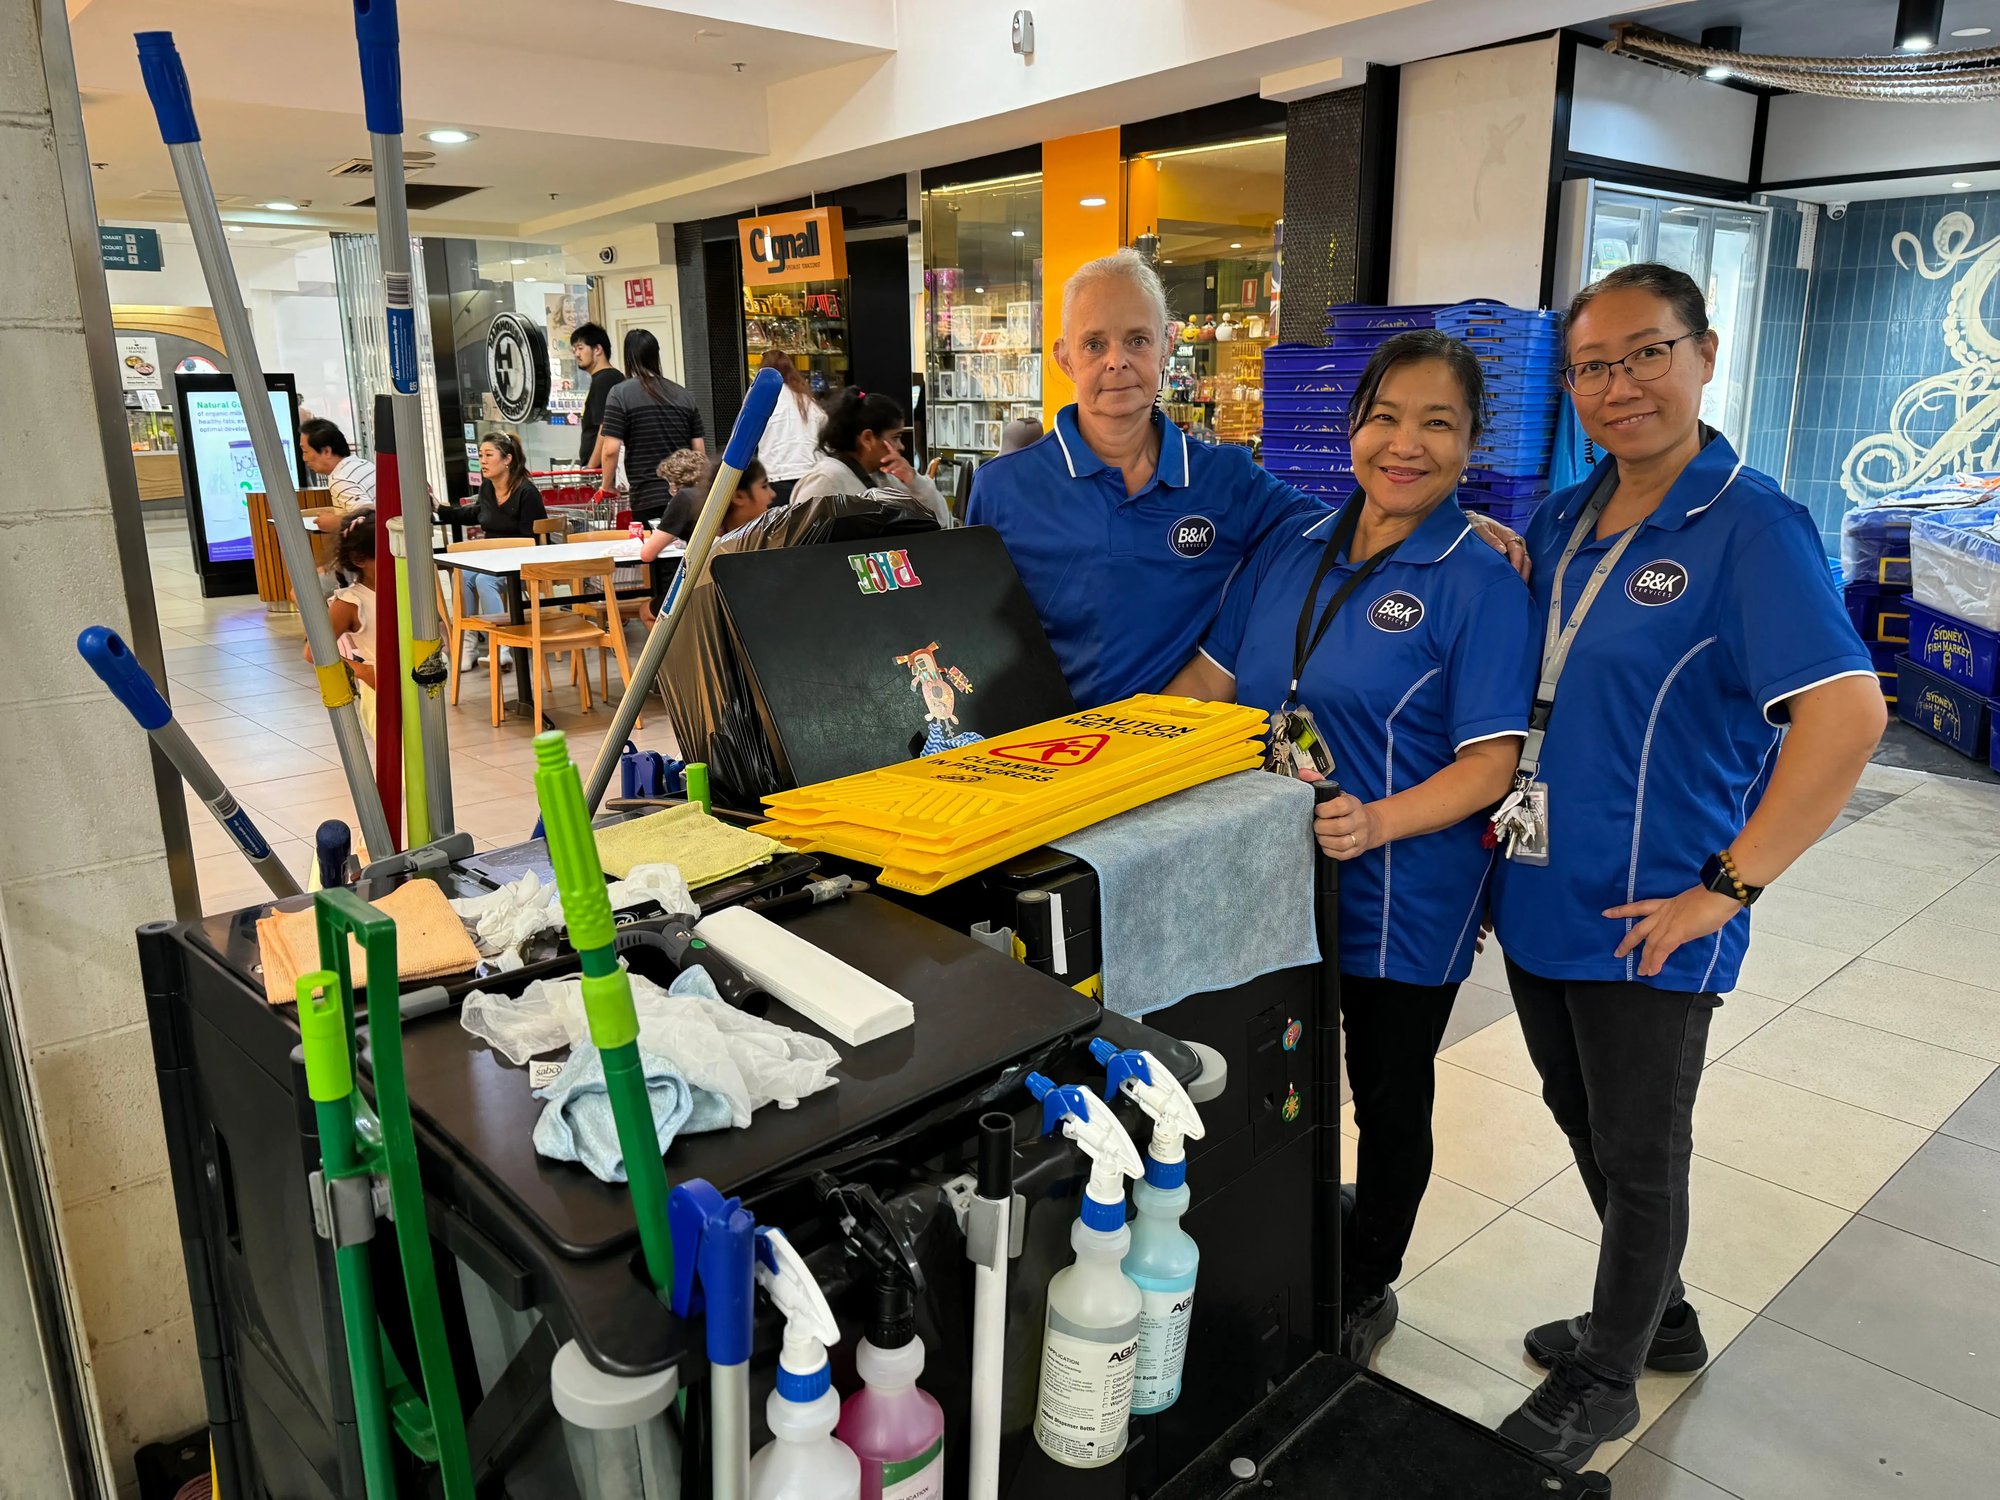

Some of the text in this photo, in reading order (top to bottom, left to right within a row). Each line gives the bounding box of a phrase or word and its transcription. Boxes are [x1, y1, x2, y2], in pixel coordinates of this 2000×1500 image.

[750, 220, 820, 274] Cignall
[197, 401, 229, 409] Natural
[1178, 527, 1210, 543] B&K
[1636, 570, 1682, 592] B&K
[1634, 586, 1672, 598] SERVICES
[1374, 612, 1408, 627] SERVICES
[1378, 600, 1420, 622] B&K
[1934, 628, 1962, 644] SYDNEY
[1928, 641, 1971, 660] FISH MARKET
[1926, 692, 1953, 710] SYDNEY
[1064, 718, 1181, 738] WET FLOOR
[1080, 713, 1198, 734] CAUTION
[927, 758, 1054, 782] IN PROGRESS
[962, 756, 1060, 774] CLEANING
[1048, 1345, 1080, 1366] APPLICATION
[1054, 1417, 1078, 1429] Dispenser
